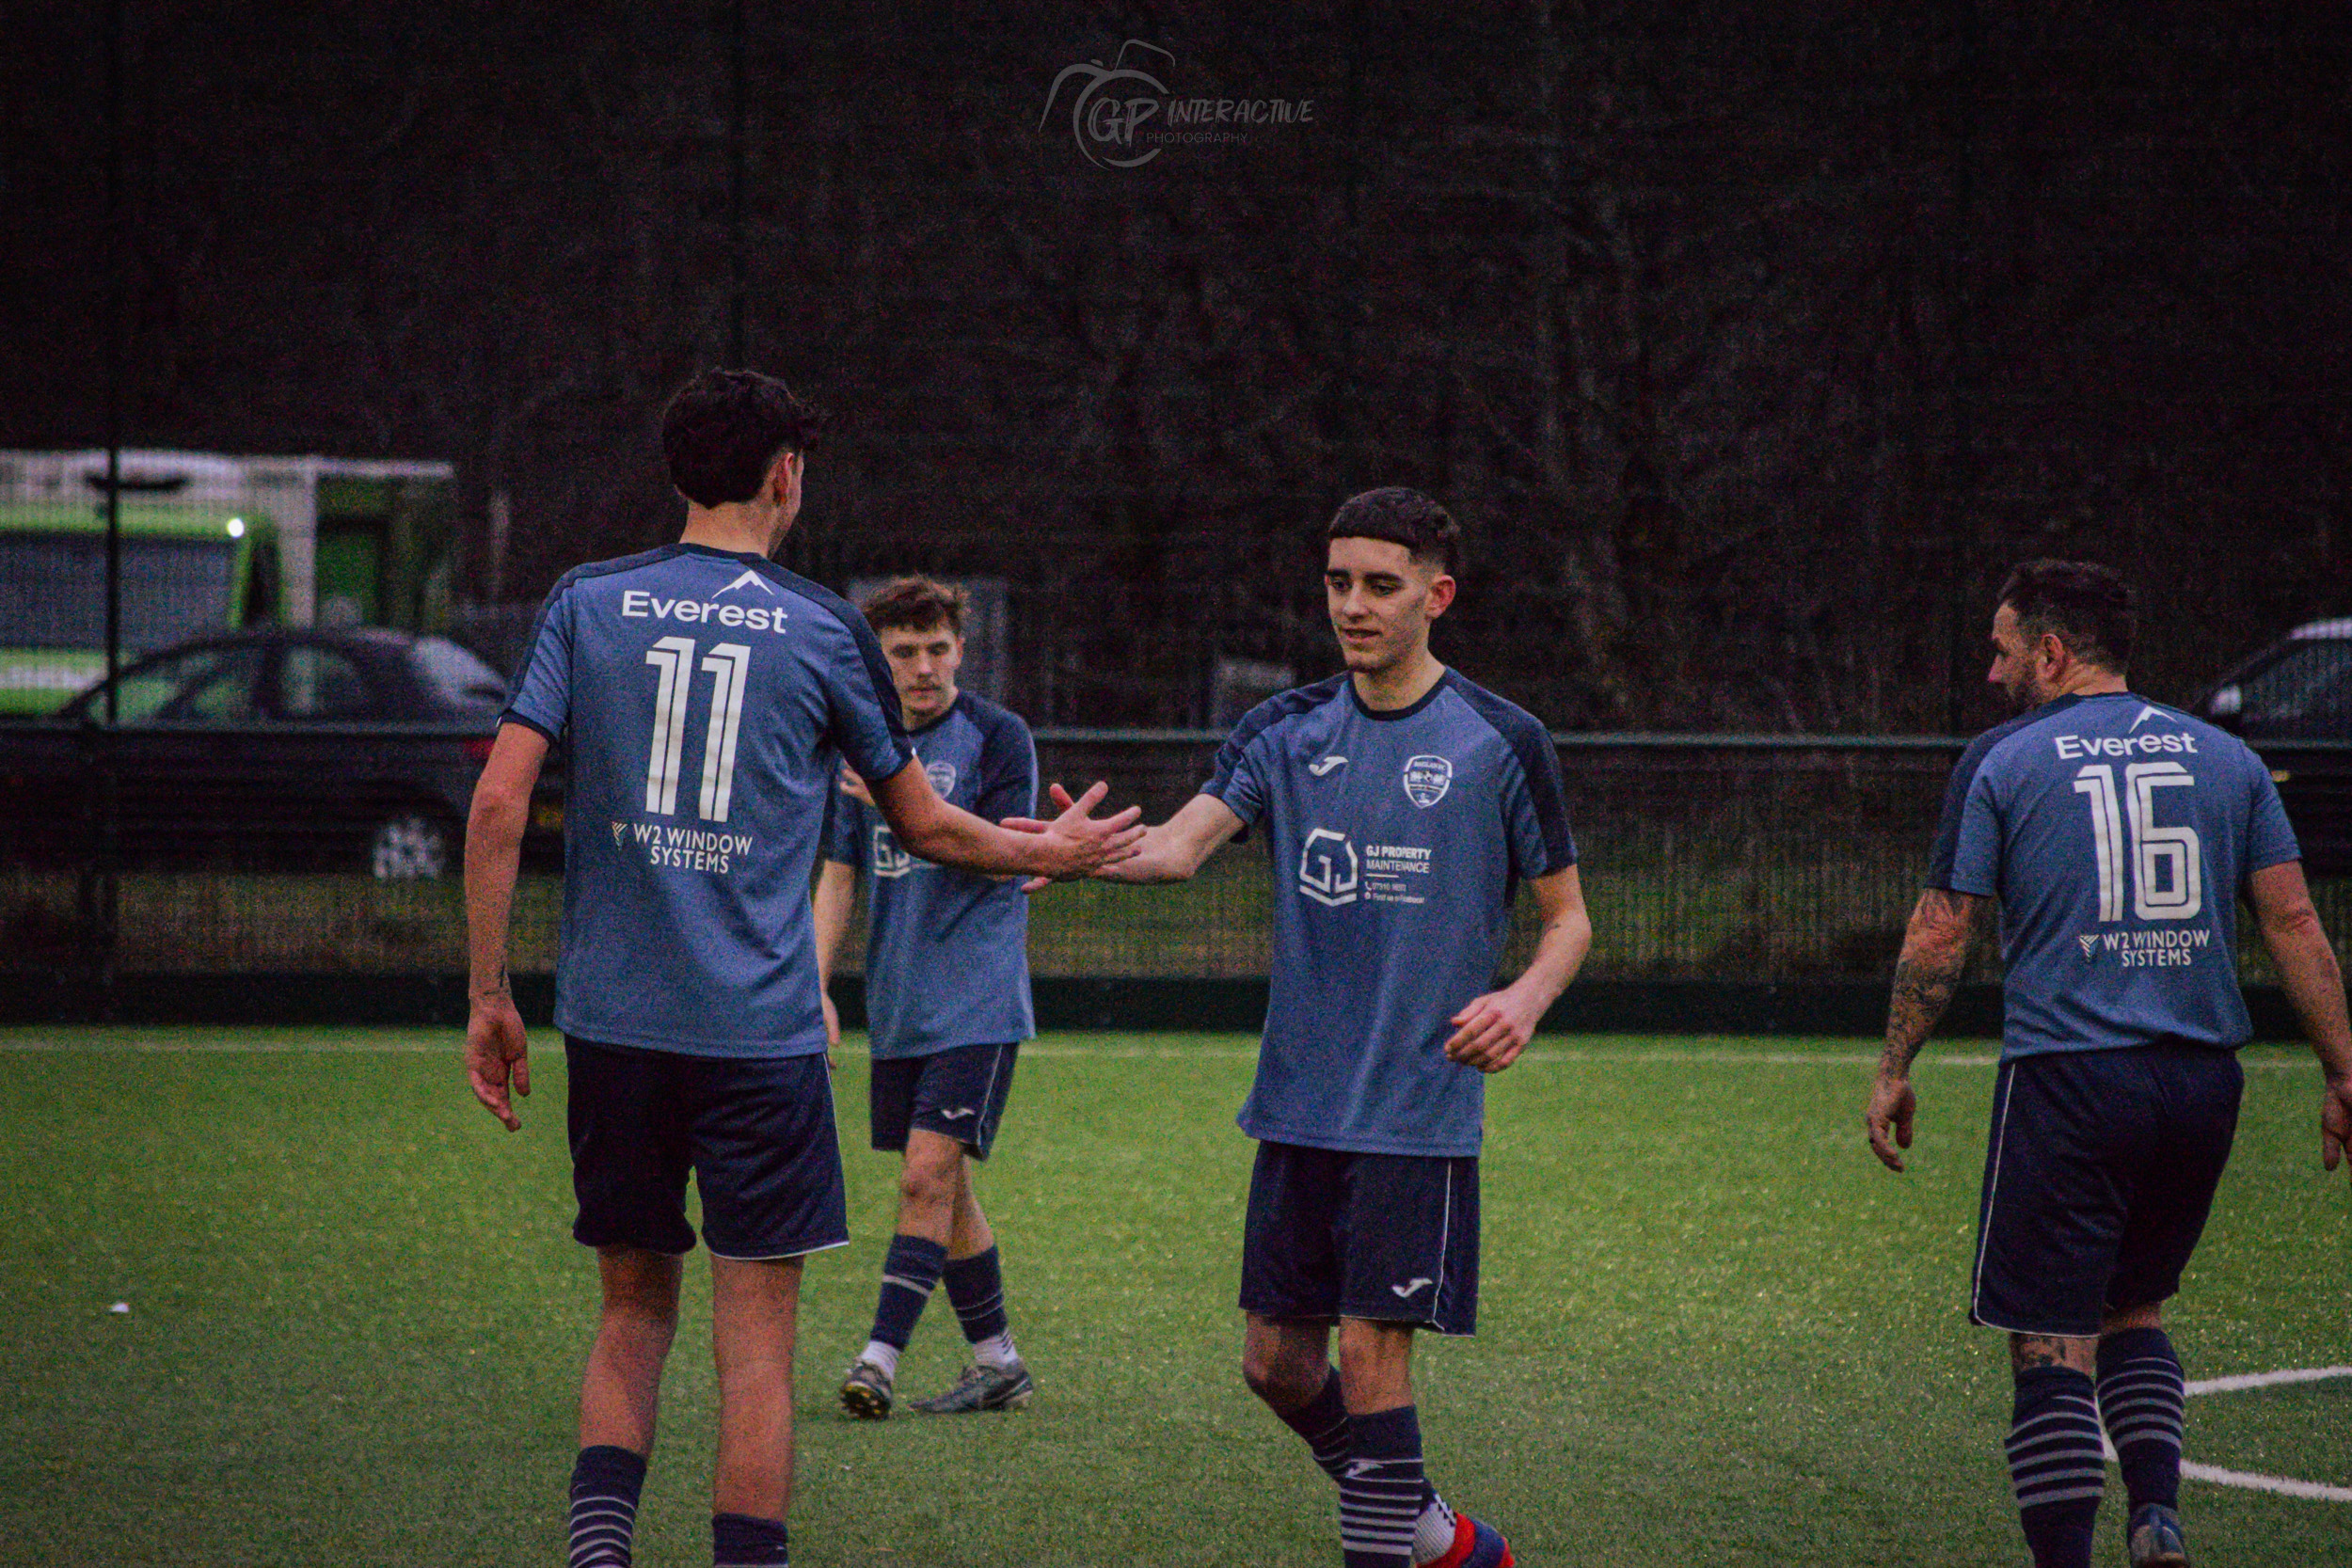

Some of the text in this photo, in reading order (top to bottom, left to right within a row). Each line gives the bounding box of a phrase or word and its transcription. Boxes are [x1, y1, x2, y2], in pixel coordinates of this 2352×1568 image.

[622, 590, 788, 634] Everest
[645, 636, 751, 823] 11
[2055, 733, 2199, 760] Everest
[633, 823, 753, 856] W2 WINDOW
[1381, 846, 1432, 860] PROPERTY
[2074, 762, 2201, 922] 16
[650, 845, 730, 874] SYSTEMS
[1366, 859, 1430, 873] MAINTENANCE
[2103, 928, 2210, 951] W2 WINDOW
[2121, 948, 2192, 967] SYSTEMS
